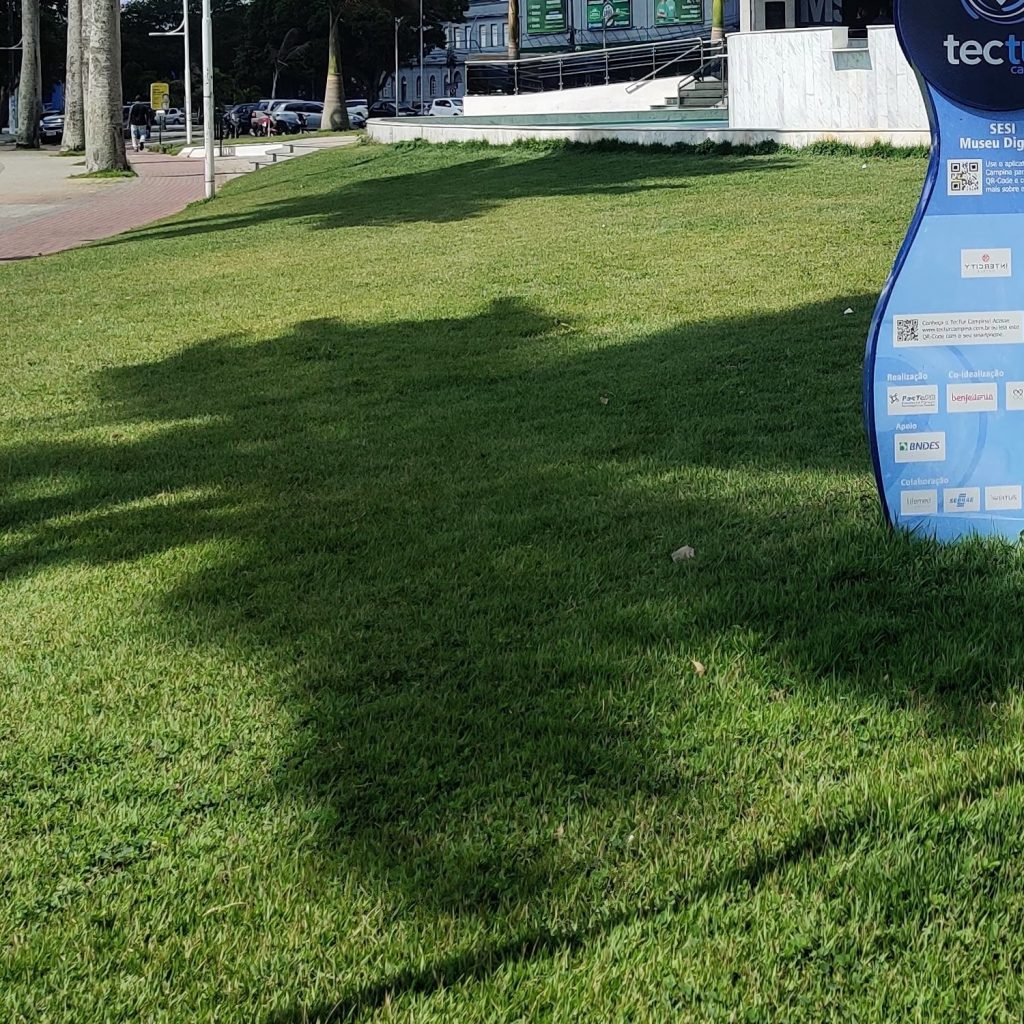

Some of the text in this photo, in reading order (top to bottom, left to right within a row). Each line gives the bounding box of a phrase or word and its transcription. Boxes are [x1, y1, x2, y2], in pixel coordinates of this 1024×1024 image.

[989, 123, 1016, 135] SESI
[959, 138, 1000, 149] Museu
[985, 177, 1013, 185] QR-Code
[887, 372, 928, 382] Realização
[948, 369, 1004, 379] Co-idealização
[895, 422, 918, 431] Apoio
[909, 441, 940, 451] BNDES
[901, 477, 949, 487] Colaboração
